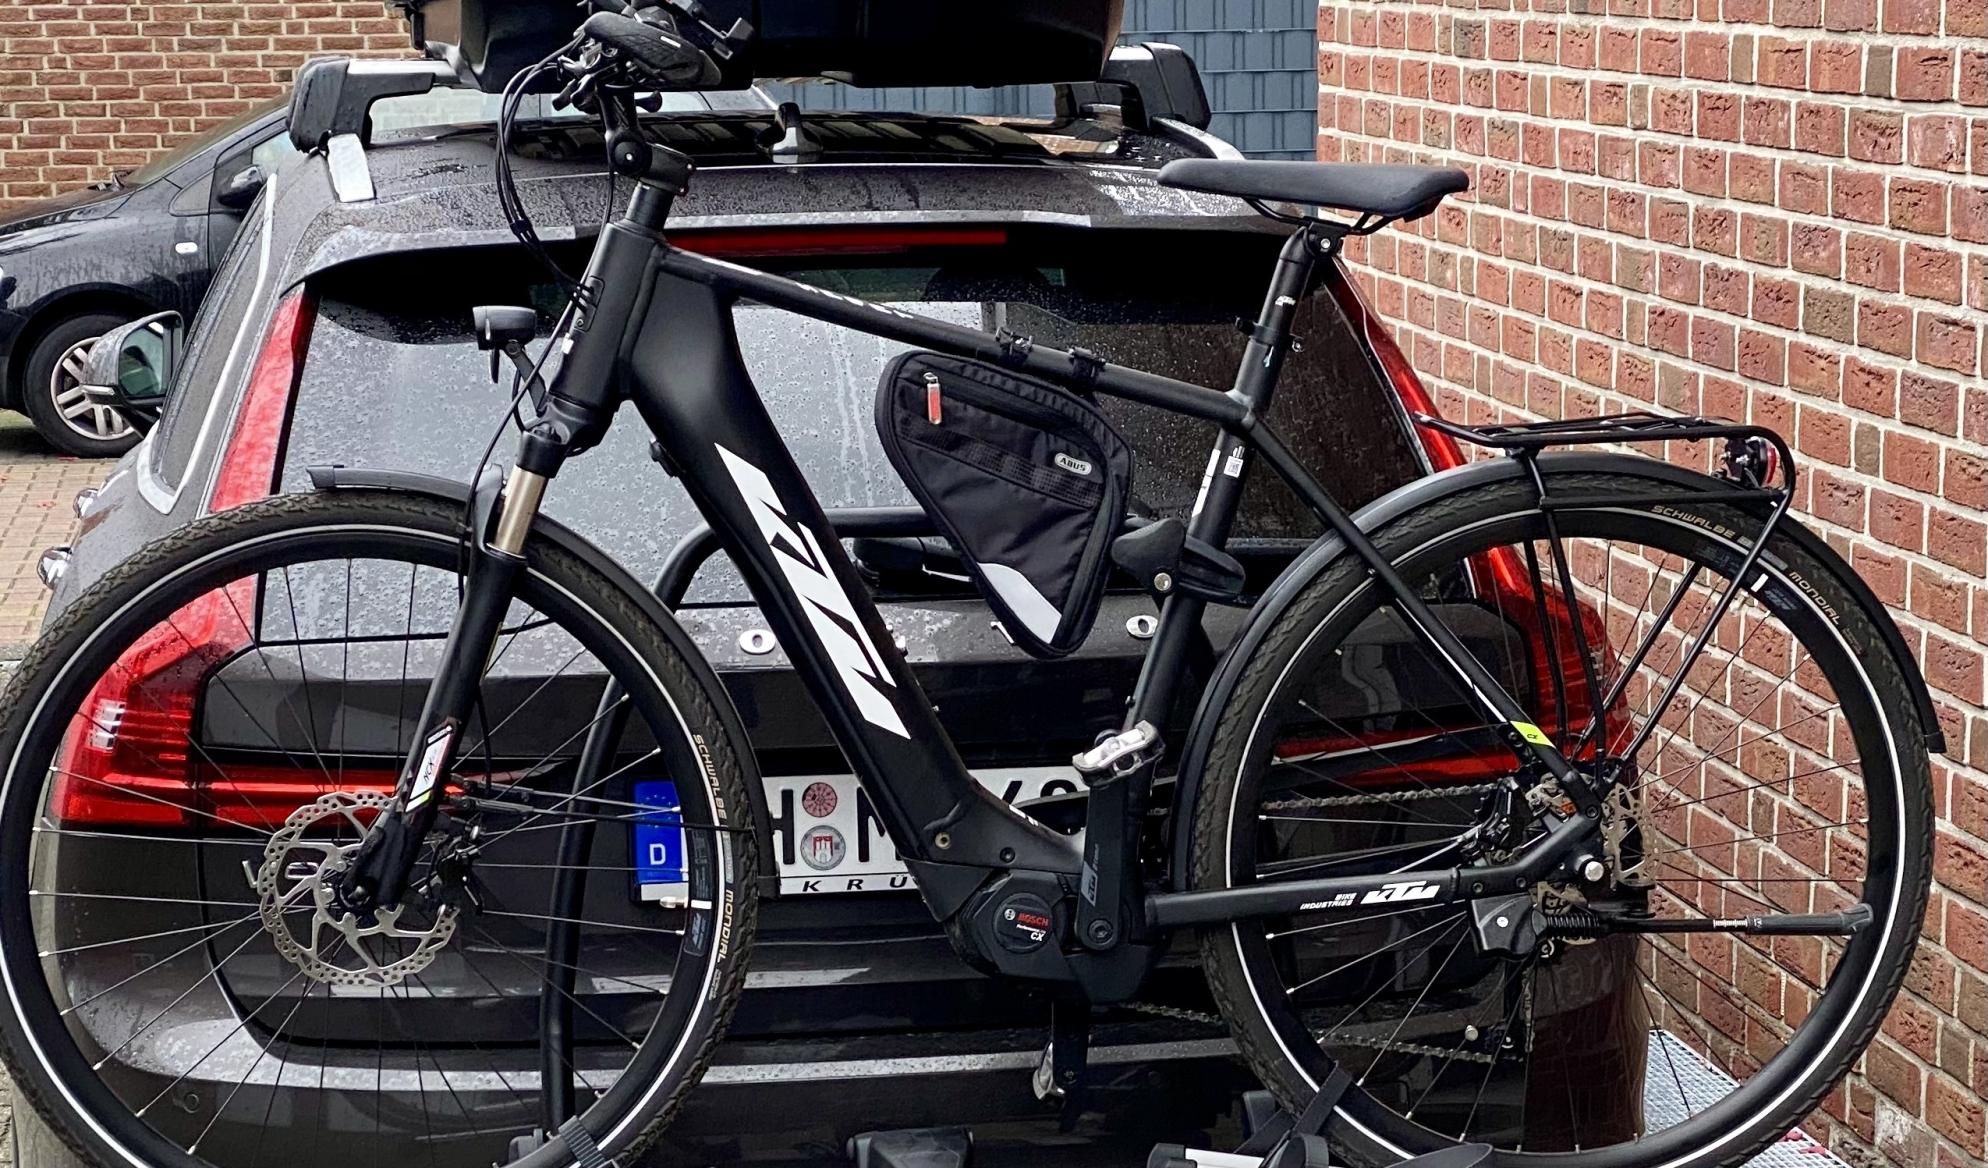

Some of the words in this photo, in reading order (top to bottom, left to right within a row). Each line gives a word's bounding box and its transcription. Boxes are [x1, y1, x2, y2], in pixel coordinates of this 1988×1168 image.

[1060, 457, 1086, 471] ABUS
[1651, 504, 1736, 539] SCHWALBE
[714, 443, 911, 740] KTM
[1788, 571, 1841, 626] MONDIAL
[693, 734, 728, 820] SCHWALBE
[649, 843, 667, 866] D
[1360, 880, 1441, 905] KTM
[717, 888, 735, 964] MONDIAL
[1017, 912, 1050, 927] BOSCH
[1030, 931, 1044, 942] CX
